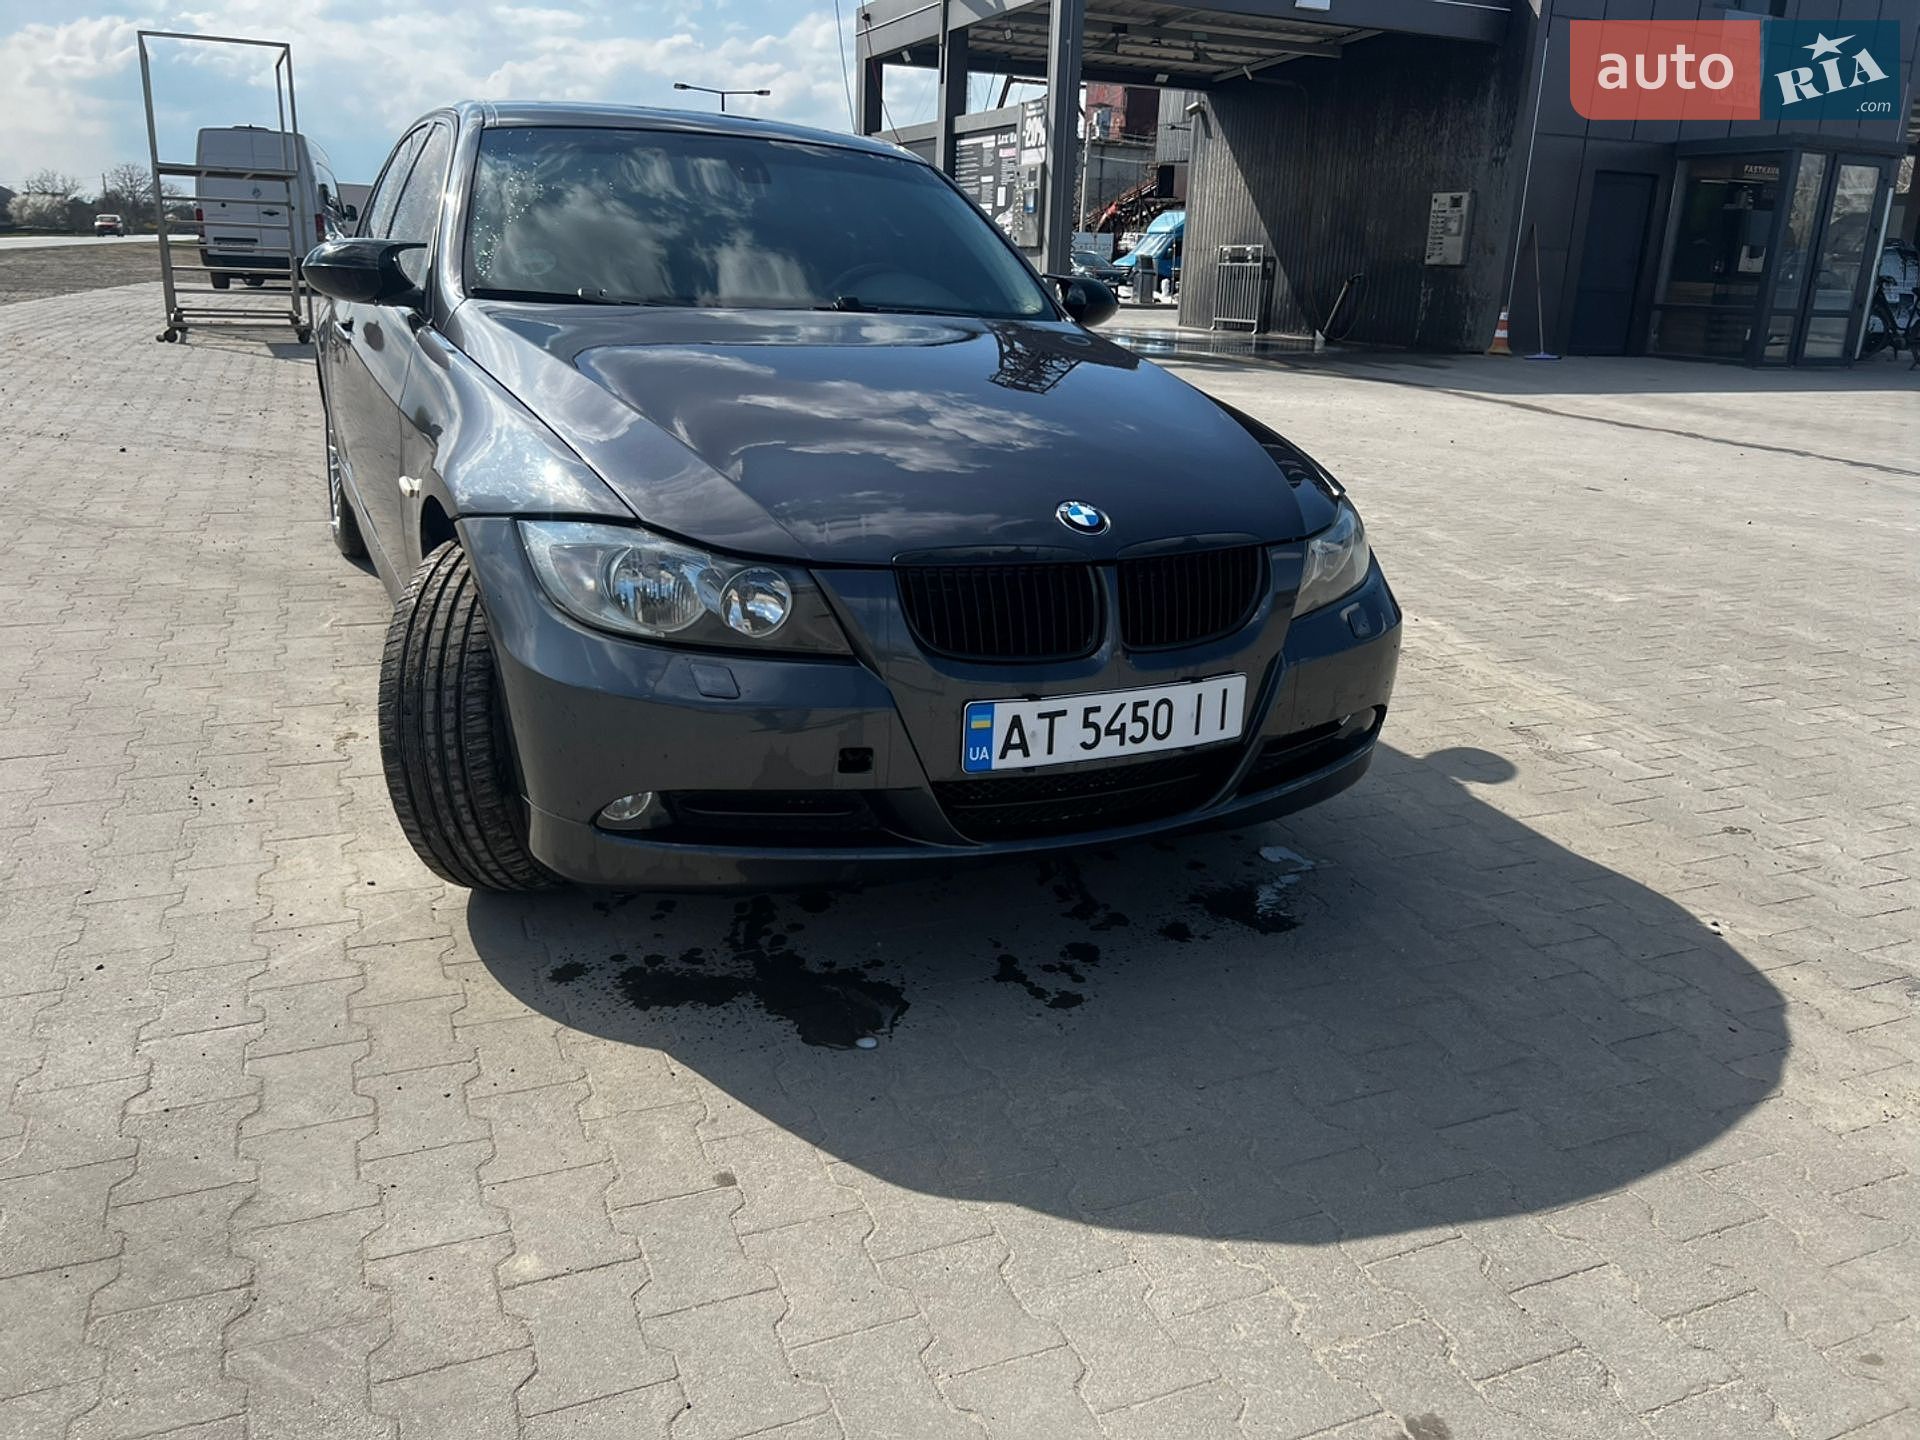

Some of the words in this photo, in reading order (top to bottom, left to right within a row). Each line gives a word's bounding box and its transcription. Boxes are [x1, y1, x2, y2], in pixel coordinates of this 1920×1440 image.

[999, 709, 1067, 760] AT
[1080, 698, 1174, 751] 5450
[969, 746, 990, 762] UA
